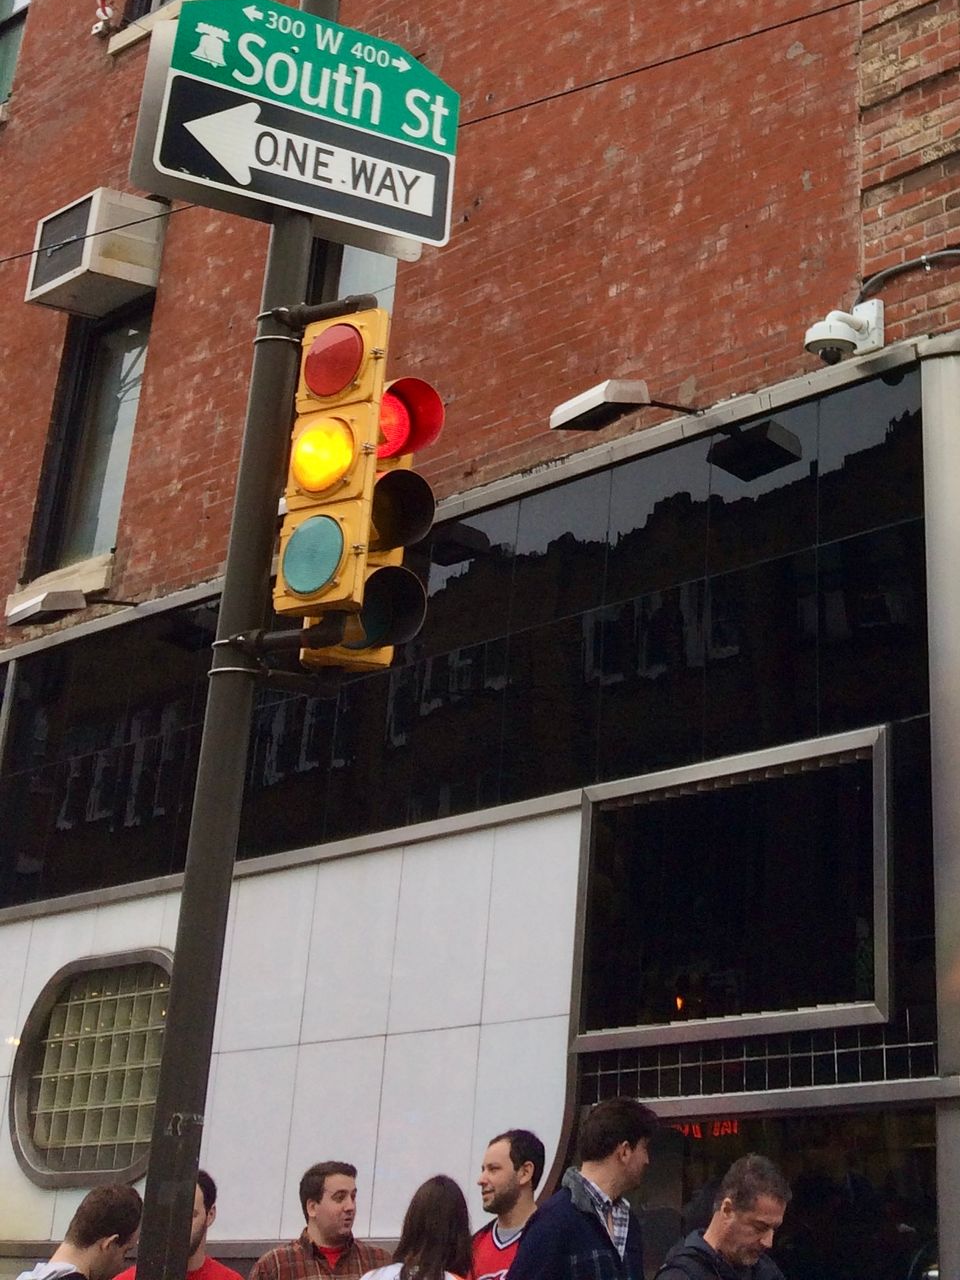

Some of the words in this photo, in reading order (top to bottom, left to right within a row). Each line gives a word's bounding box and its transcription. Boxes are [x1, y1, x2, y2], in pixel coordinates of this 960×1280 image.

[265, 11, 306, 39] 300
[315, 24, 344, 55] W
[350, 42, 390, 68] 400
[231, 33, 383, 126] South
[401, 88, 449, 146] St
[254, 130, 335, 184] ONE
[350, 156, 421, 206] WAY
